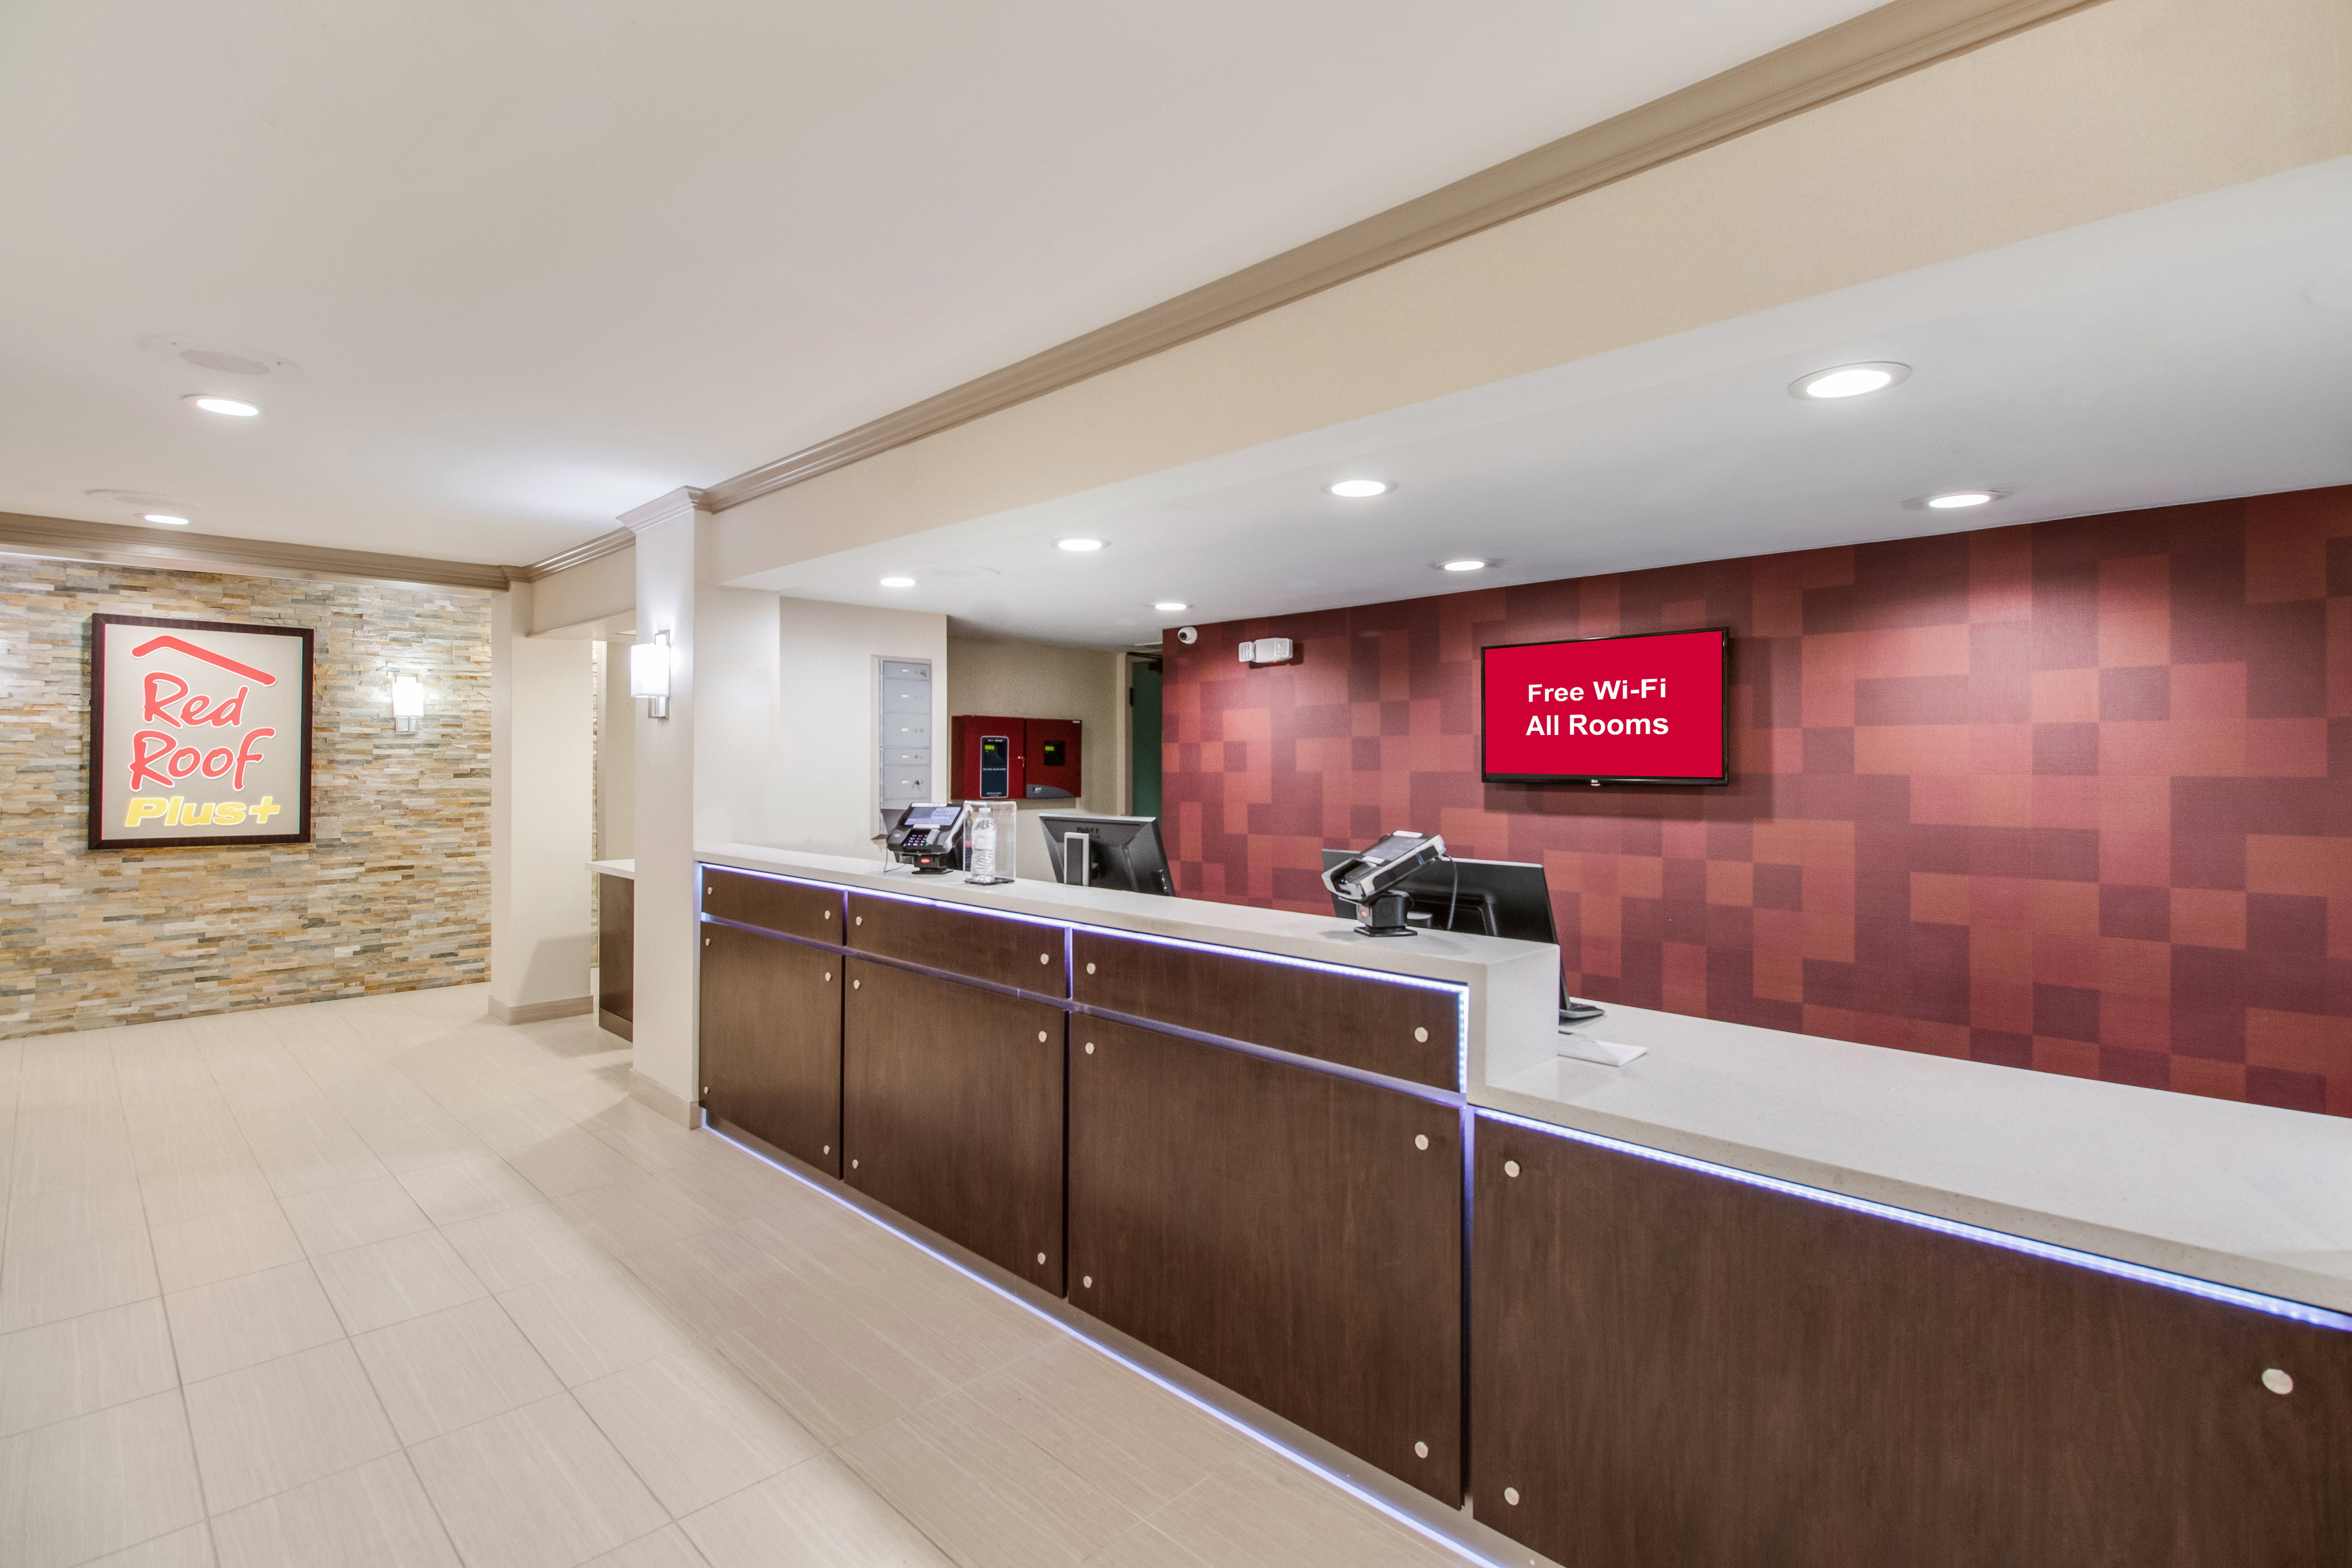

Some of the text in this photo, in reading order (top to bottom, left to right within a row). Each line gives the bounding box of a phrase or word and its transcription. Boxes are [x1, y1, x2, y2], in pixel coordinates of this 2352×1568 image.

[144, 671, 249, 728] Red
[1528, 678, 1666, 702] Free Wi-Fi
[1525, 714, 1669, 736] All Rooms
[128, 728, 276, 791] Roof
[125, 796, 280, 827] Plus+
